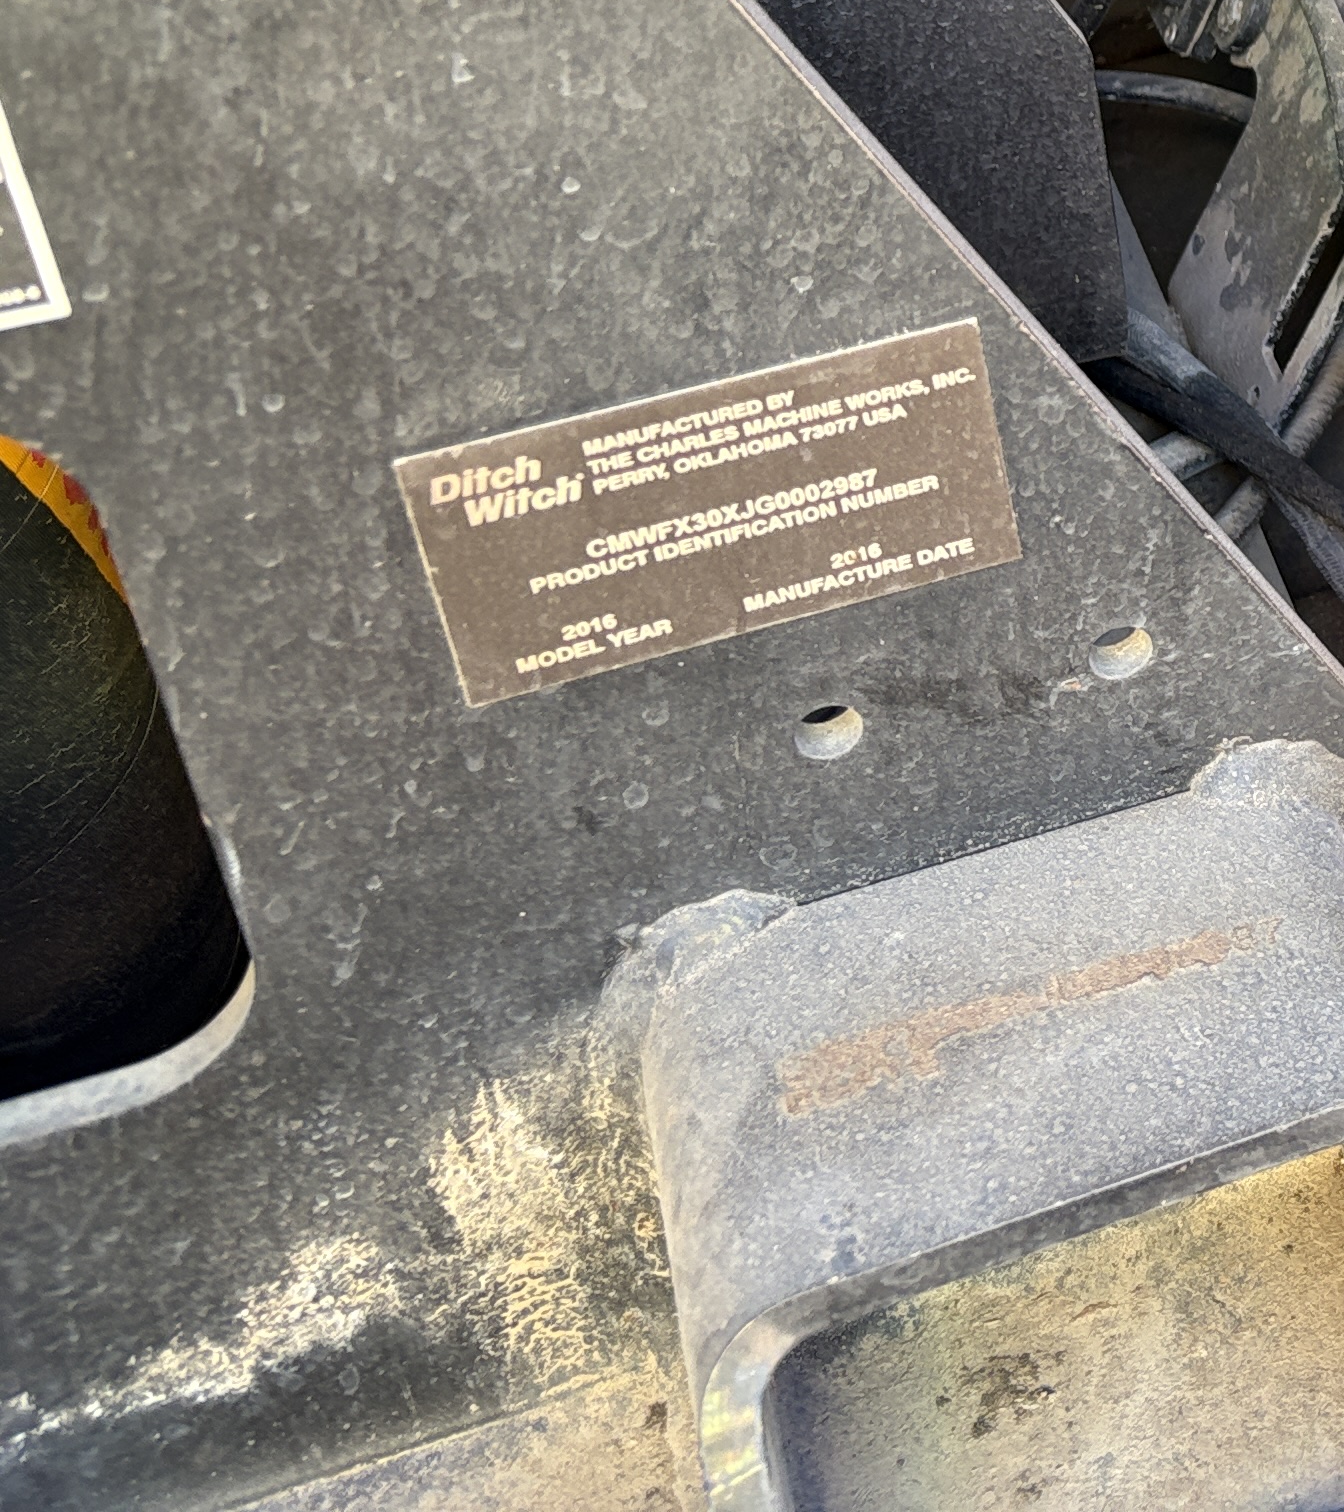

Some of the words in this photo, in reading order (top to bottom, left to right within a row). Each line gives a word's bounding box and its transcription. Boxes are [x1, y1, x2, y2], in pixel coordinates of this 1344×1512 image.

[582, 398, 764, 456] MANUFACTURED
[766, 389, 795, 411] BY
[586, 450, 635, 476] THE
[636, 425, 740, 462] CHARLES
[742, 399, 844, 437] MACHINE
[845, 379, 931, 411] WORKS,
[932, 367, 977, 389] INC.
[593, 462, 671, 495] PERRY,
[673, 431, 799, 474] OKLAHOMA
[799, 415, 860, 443] 73077
[862, 403, 908, 427] USA
[430, 456, 542, 506] Ditch
[463, 473, 585, 528] Witch
[585, 468, 878, 558] CMWFX30XJG0002987
[529, 549, 650, 595] PRODUCT
[653, 500, 838, 562] IDENTIFICATION
[840, 475, 940, 514] NUMBER
[830, 542, 883, 570] 2016
[742, 554, 914, 613] MANUFACTURE
[916, 537, 976, 566] DATE
[515, 639, 606, 674] MODEL
[606, 618, 674, 648] YEAR
[561, 613, 618, 641] 2016
